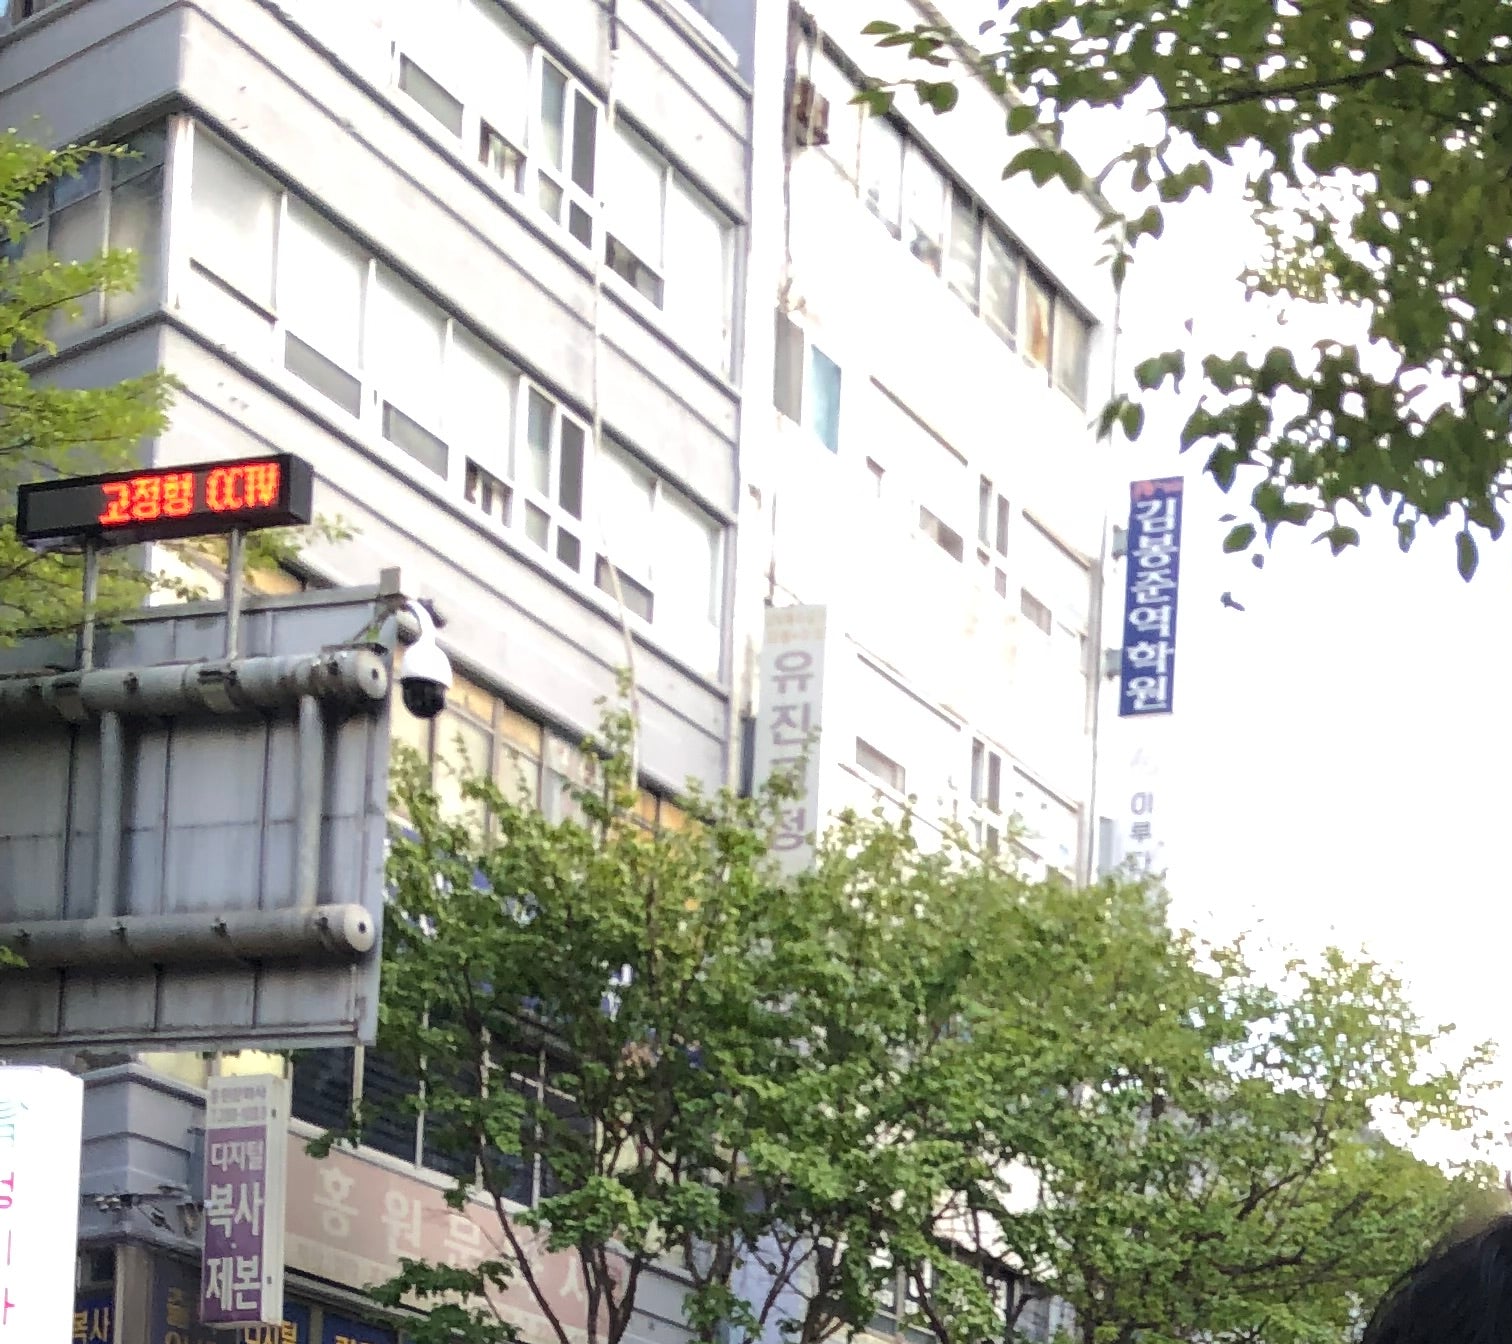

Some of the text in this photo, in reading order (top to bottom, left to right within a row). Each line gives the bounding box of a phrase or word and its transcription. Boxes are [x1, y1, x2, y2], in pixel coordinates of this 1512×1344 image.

[99, 461, 281, 526] 고정형 CCTV
[209, 1141, 264, 1170] 디지털
[208, 1182, 264, 1237] 복사
[207, 1257, 262, 1312] 제본
